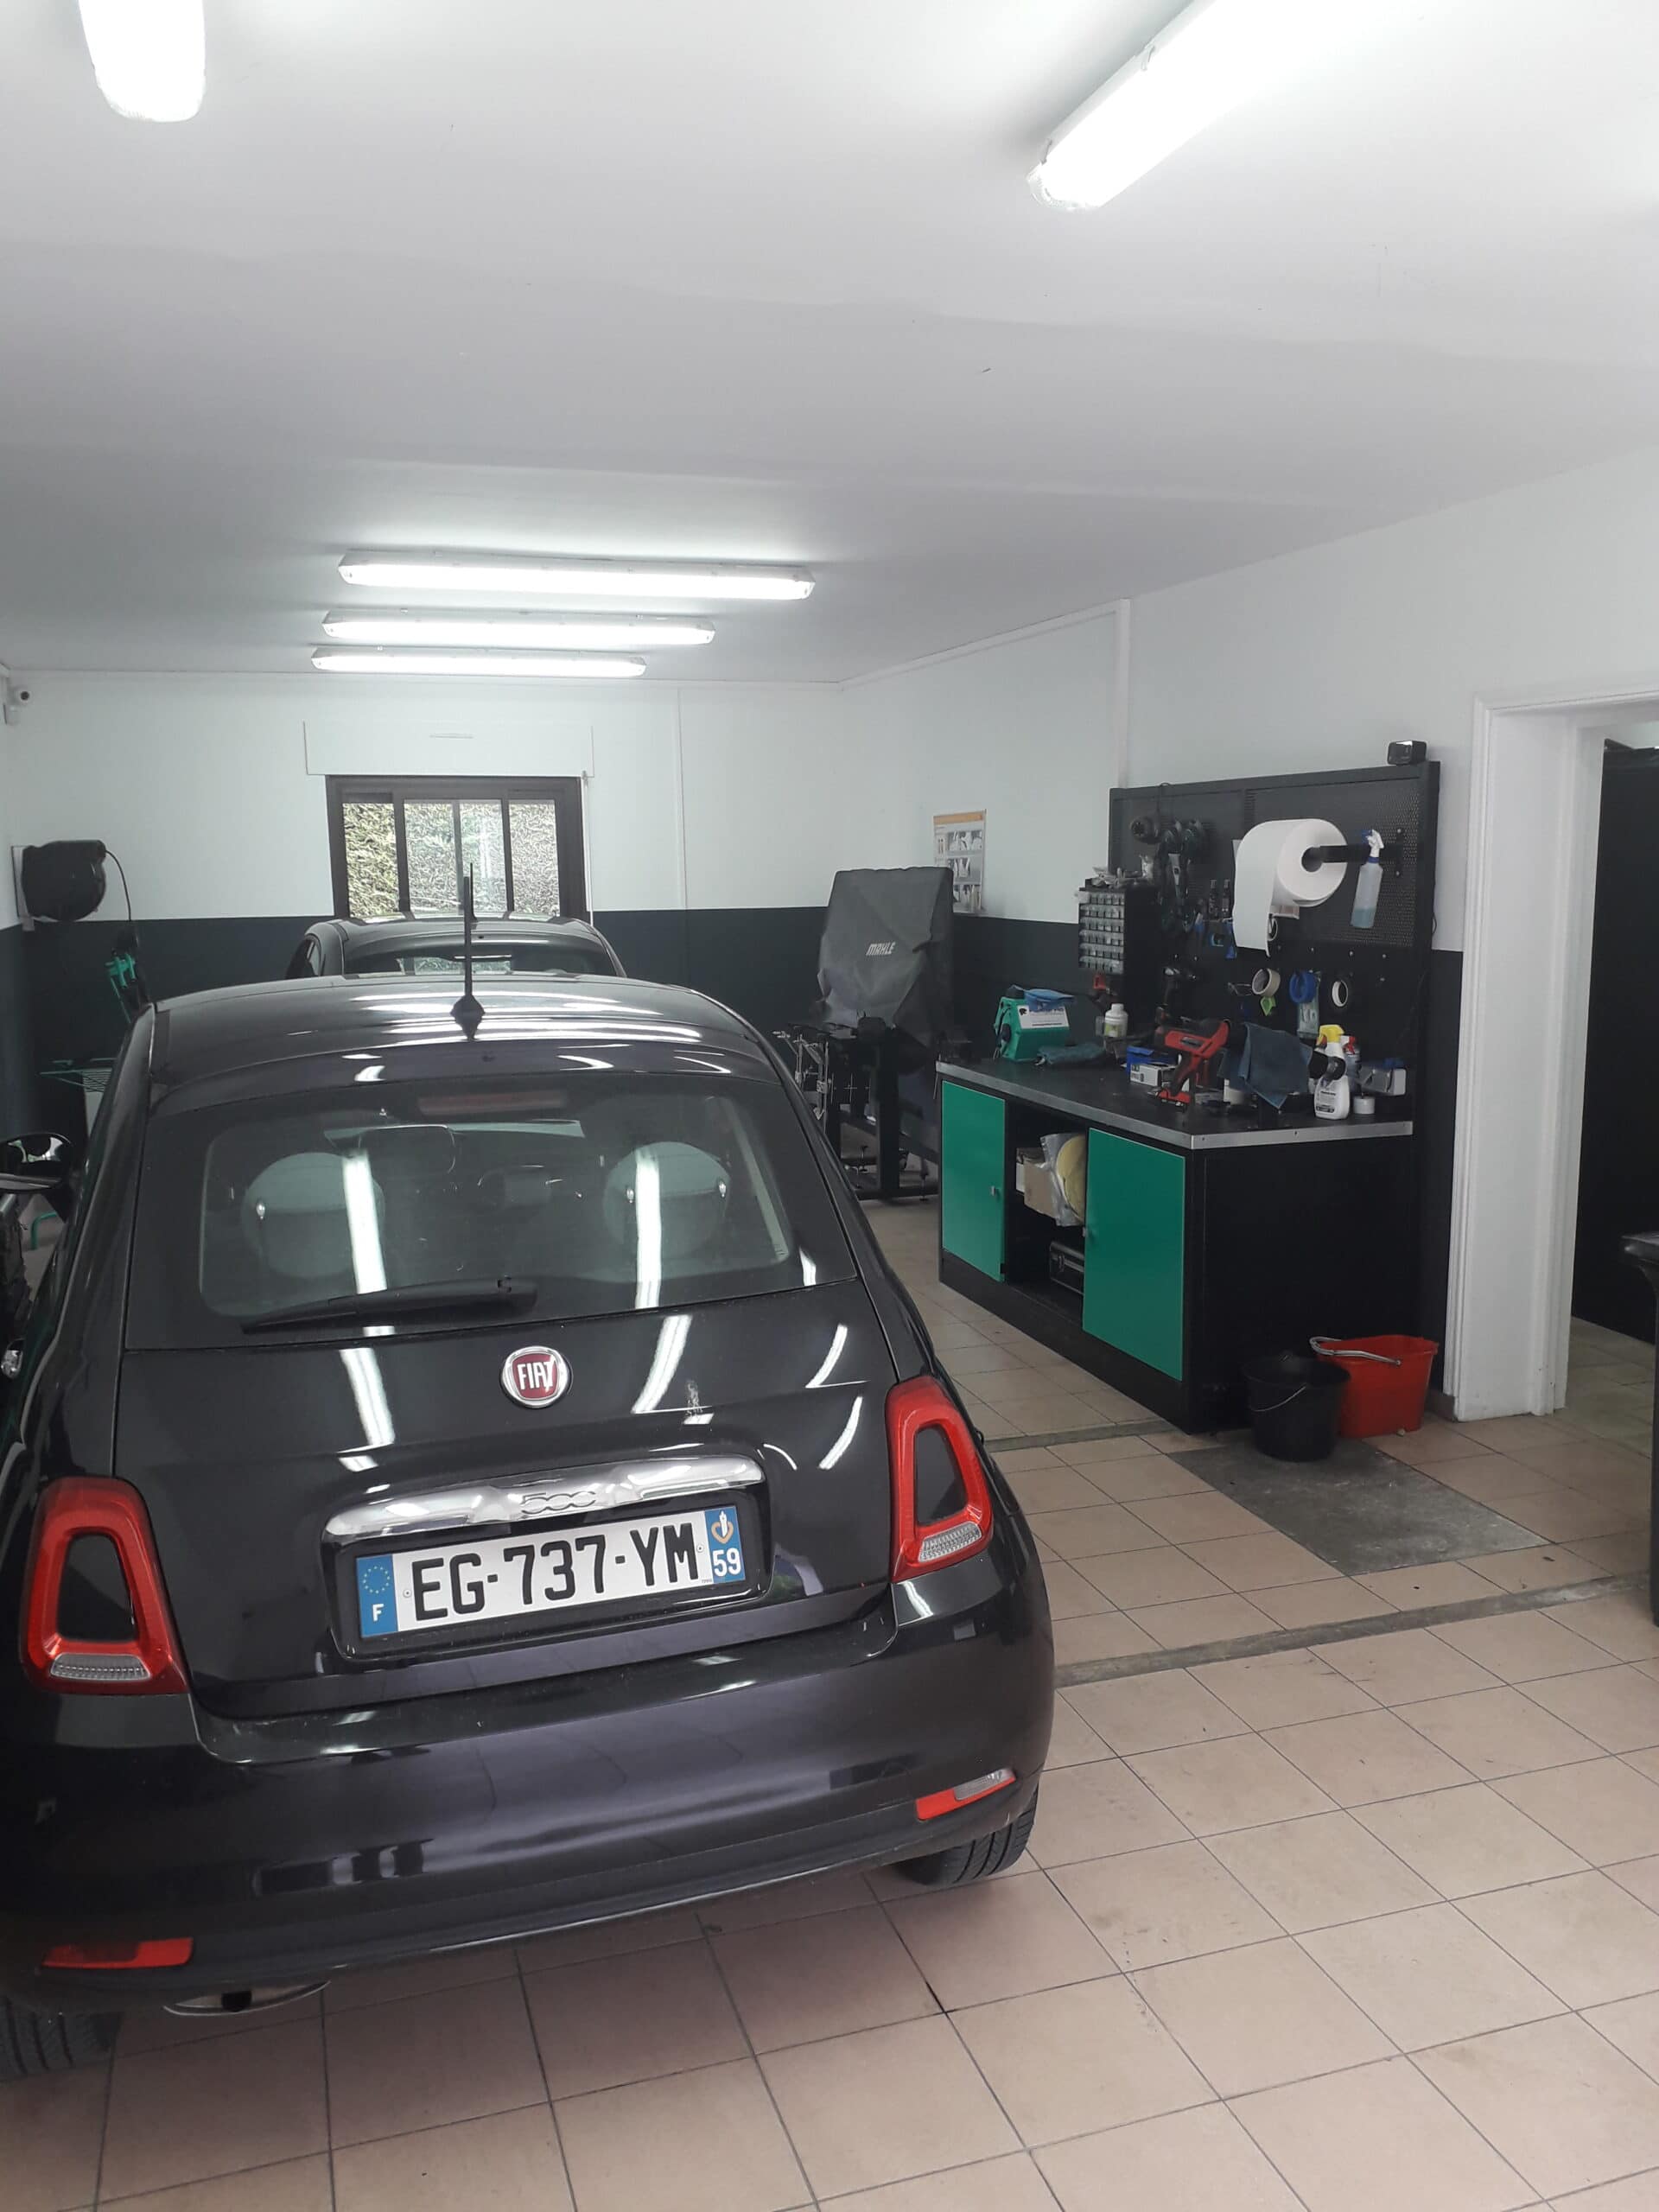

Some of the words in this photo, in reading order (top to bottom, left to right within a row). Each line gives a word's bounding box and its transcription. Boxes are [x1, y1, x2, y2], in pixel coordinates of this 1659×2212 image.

[866, 941, 896, 956] MAHLE
[517, 1360, 555, 1390] FIAT
[519, 1491, 596, 1514] 500
[411, 1522, 699, 1621] EG-737-YM
[712, 1548, 741, 1577] 59
[372, 1603, 385, 1622] F
